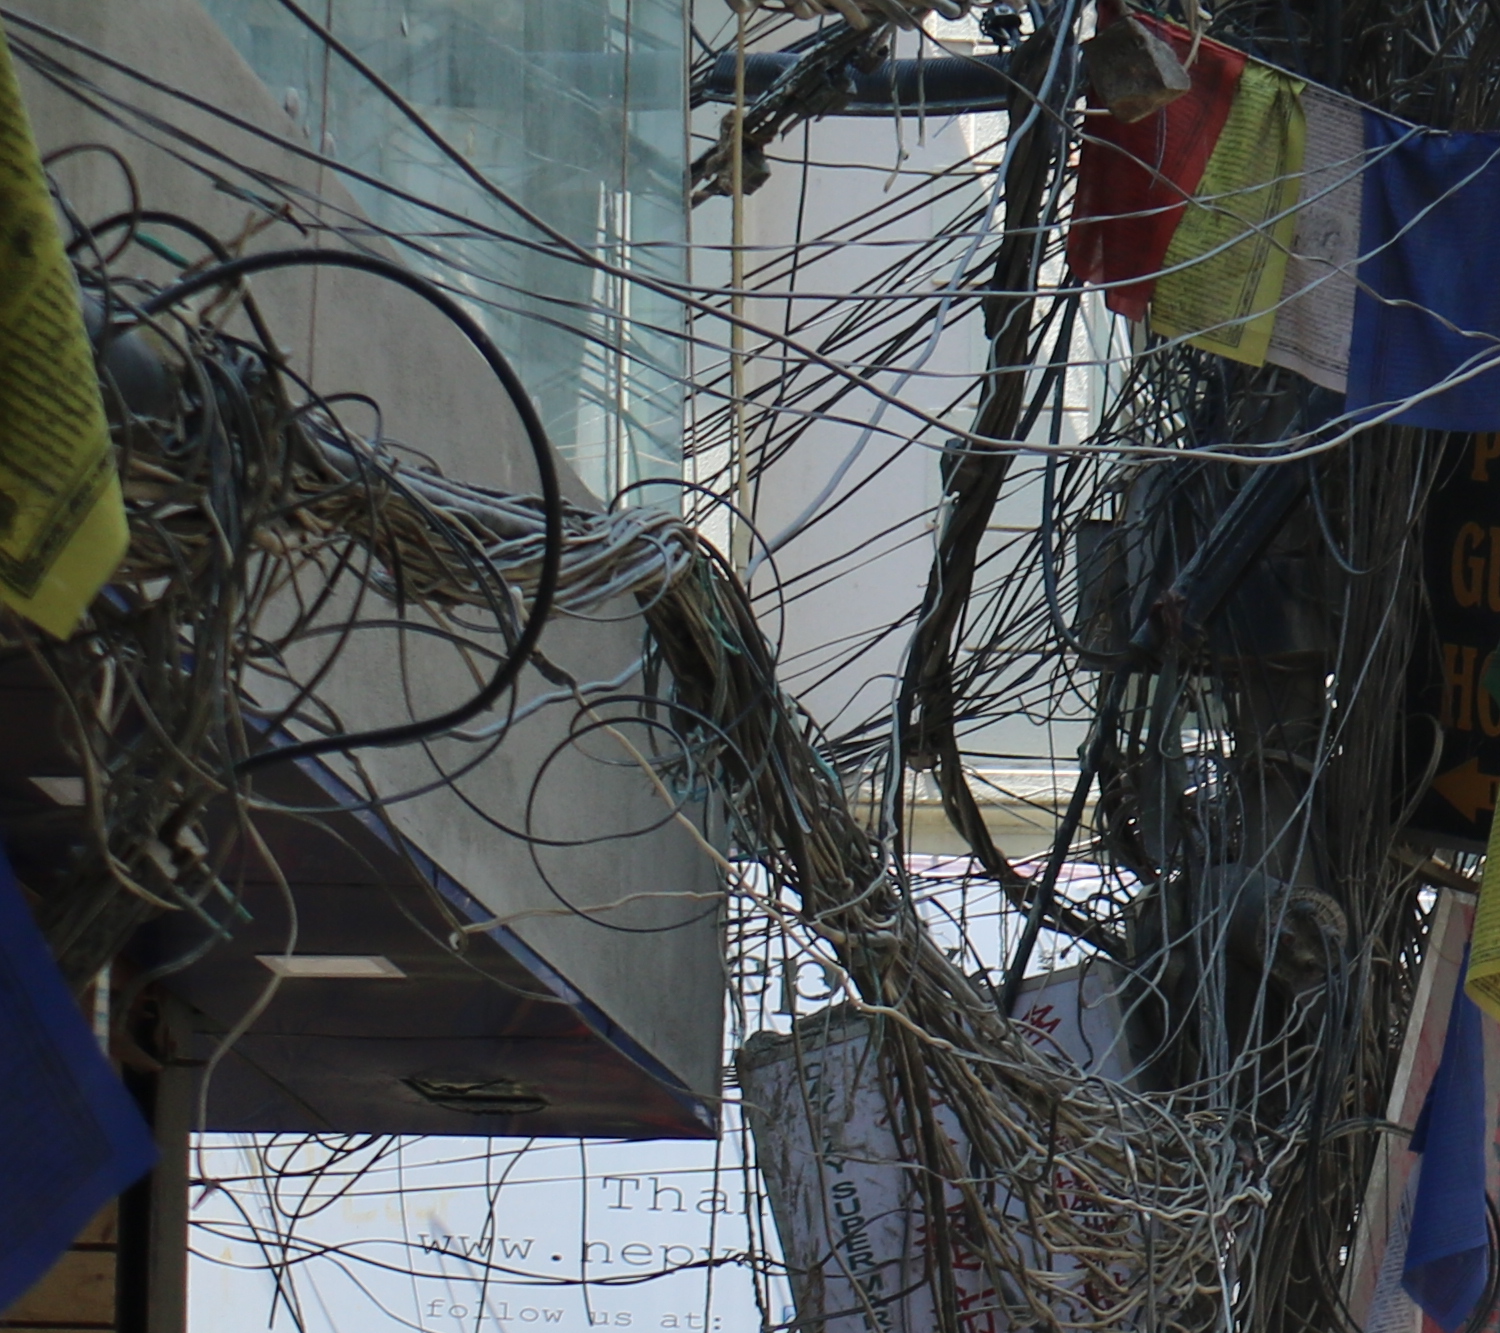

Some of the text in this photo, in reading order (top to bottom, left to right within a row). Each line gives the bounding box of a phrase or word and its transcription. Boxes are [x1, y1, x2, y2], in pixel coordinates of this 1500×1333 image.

[427, 1301, 722, 1331] follow us at:
